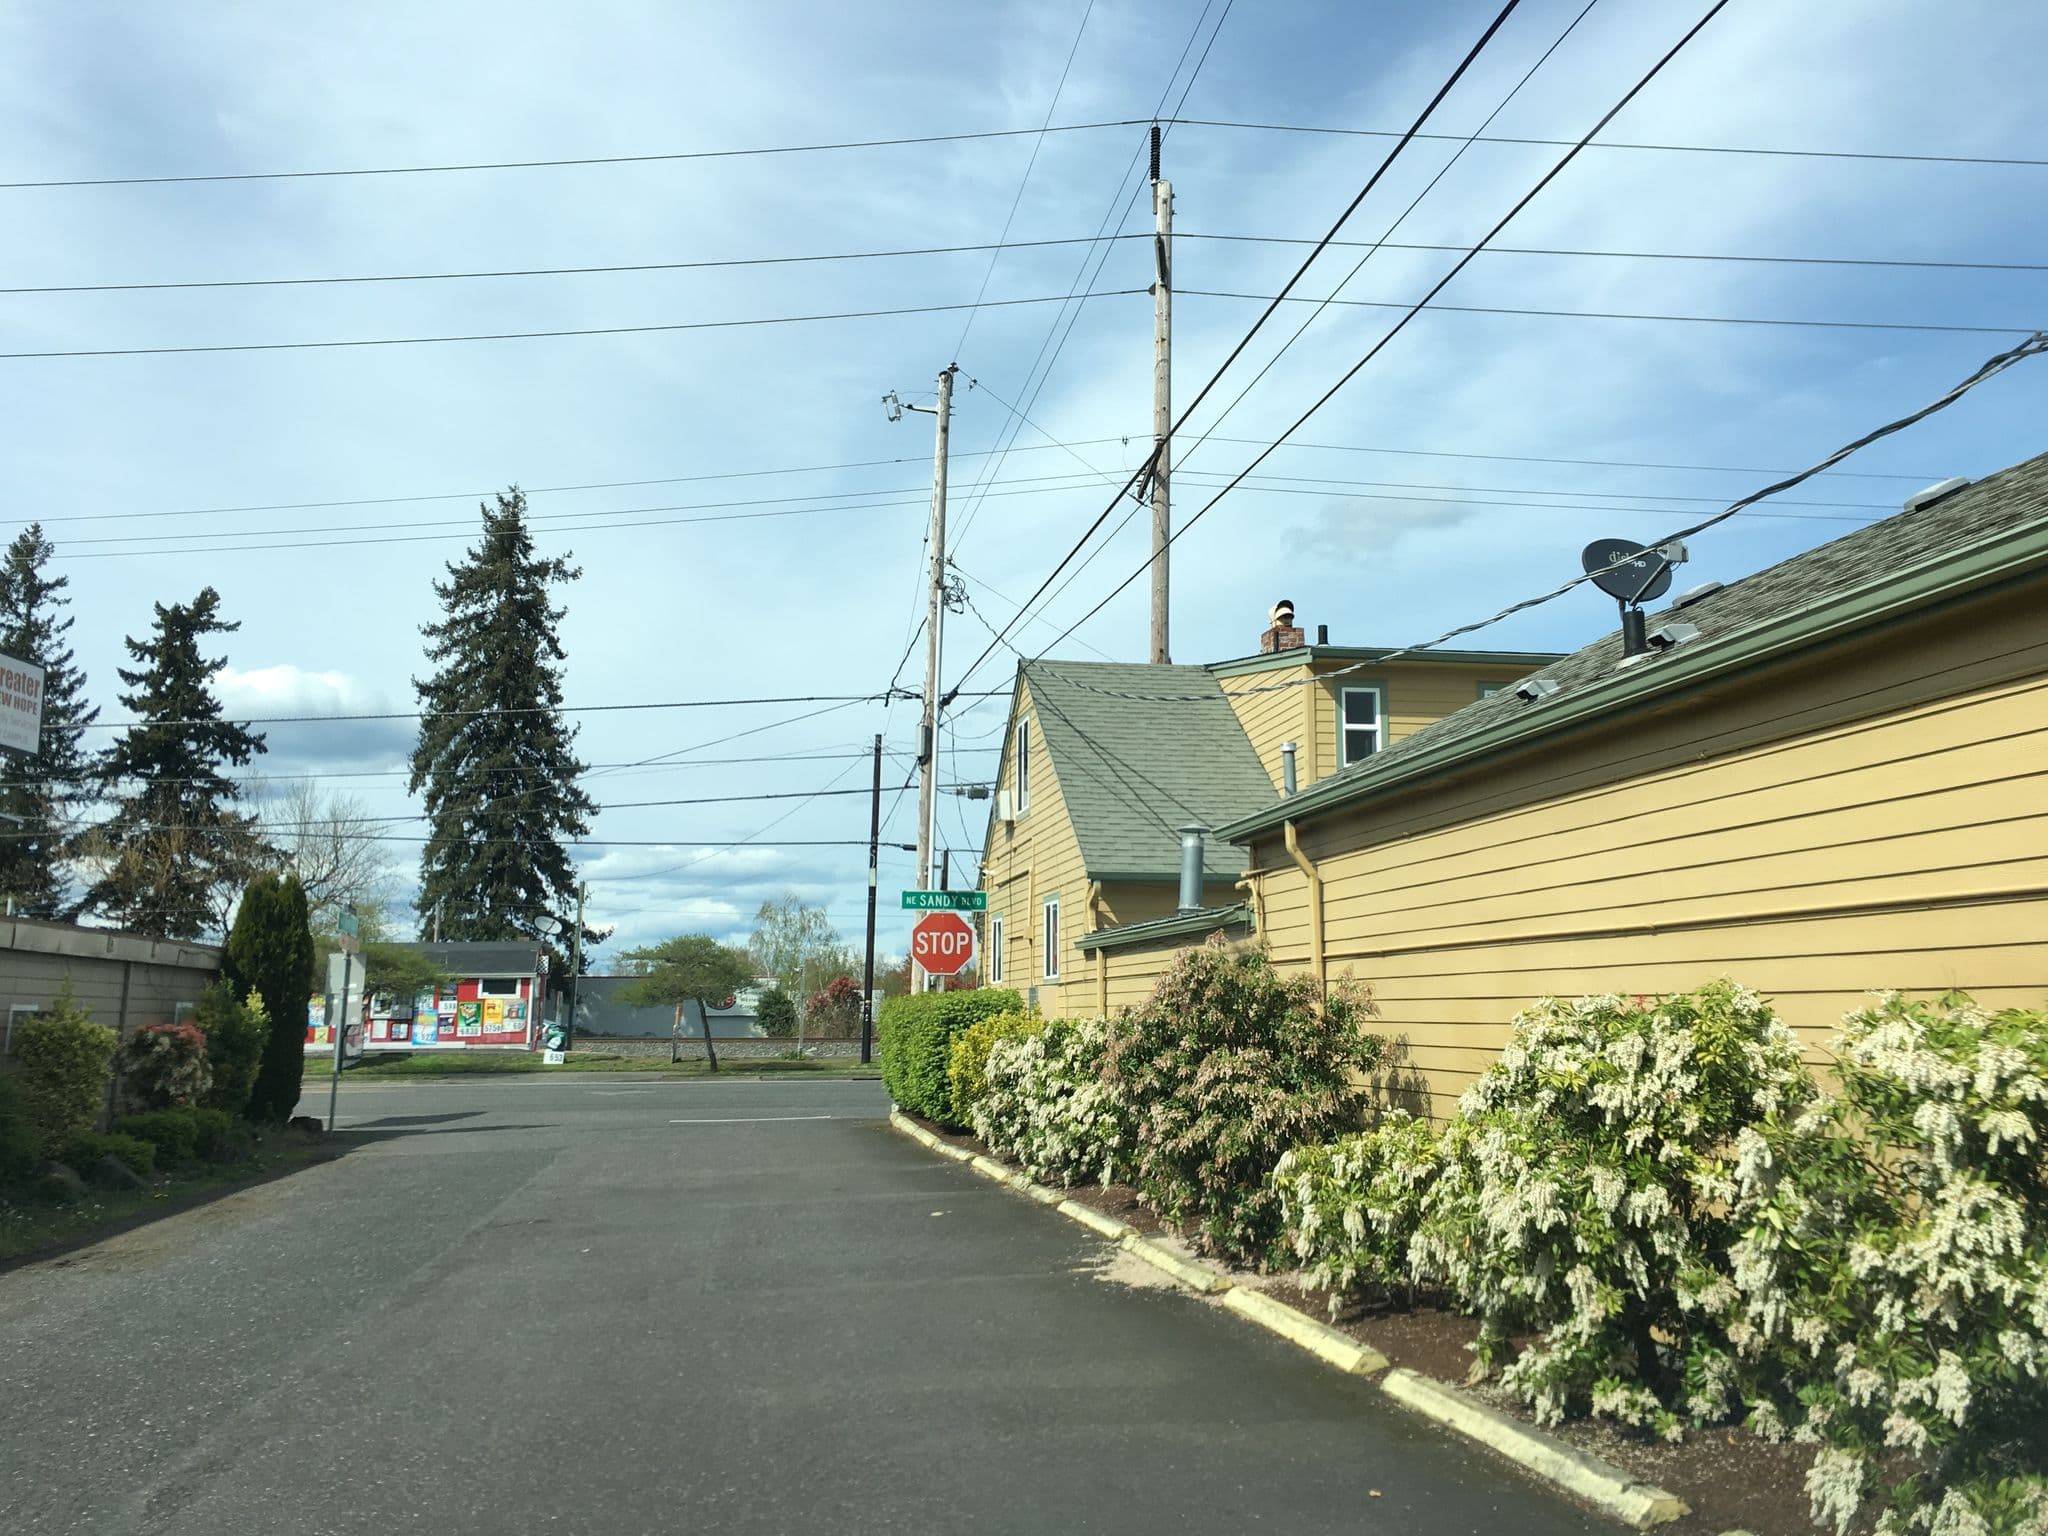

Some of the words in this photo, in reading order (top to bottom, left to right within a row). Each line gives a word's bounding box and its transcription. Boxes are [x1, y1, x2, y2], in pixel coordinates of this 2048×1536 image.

[14, 695, 38, 716] HOPE
[906, 896, 917, 905] NE
[919, 894, 958, 908] SANDY
[961, 896, 982, 906] BLVD
[915, 931, 970, 955] STOP
